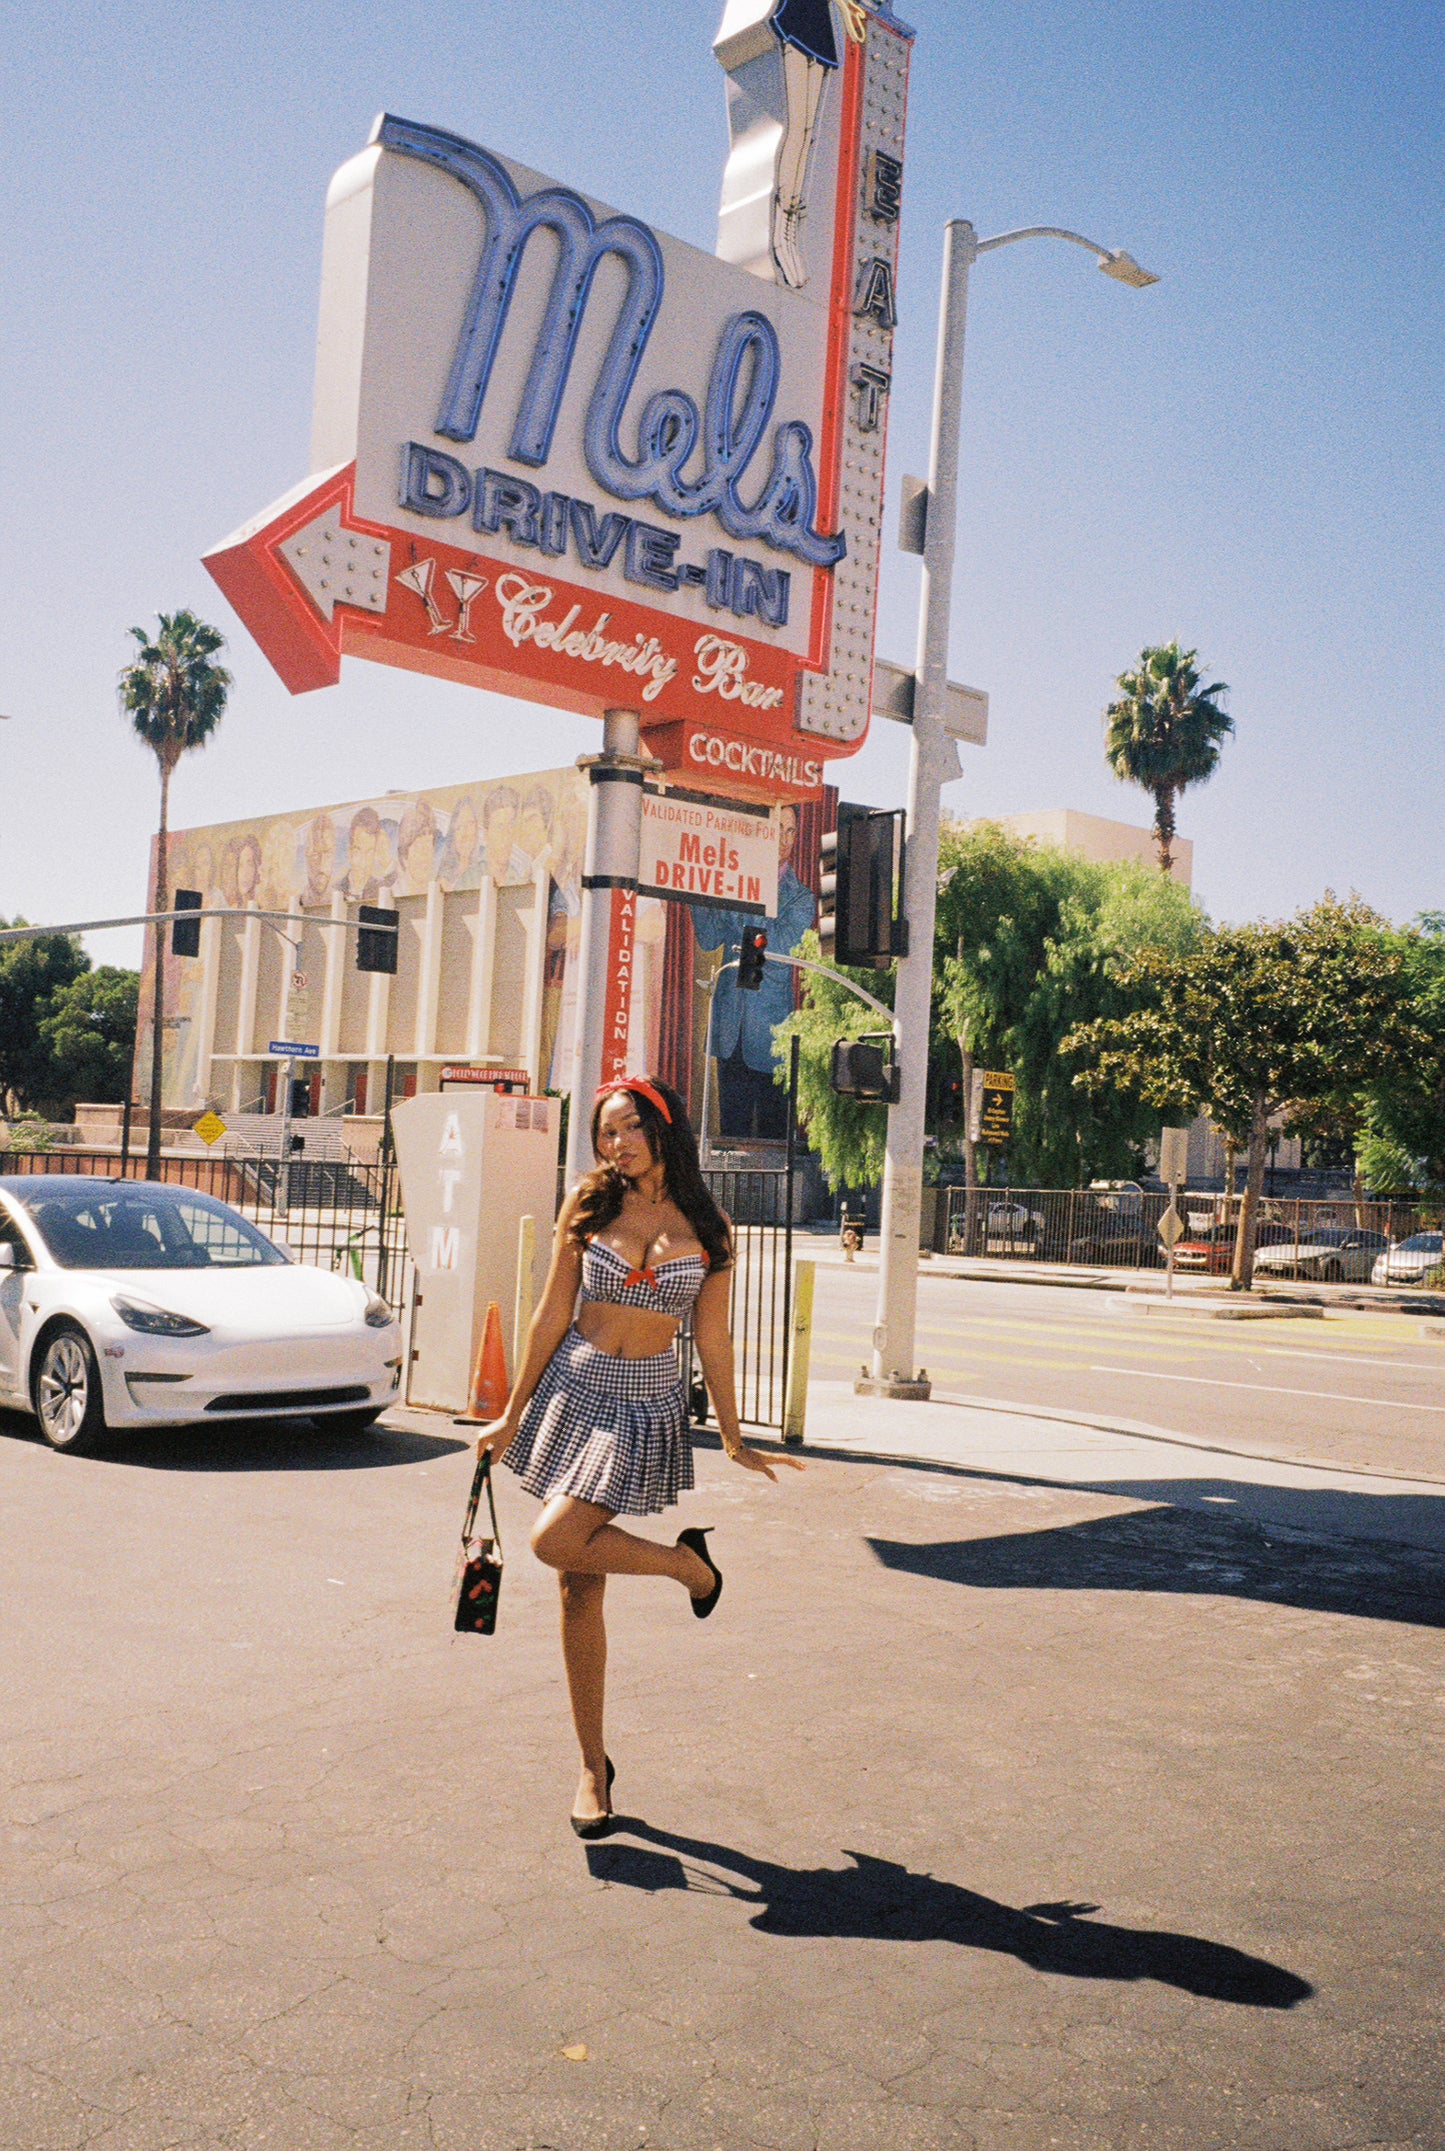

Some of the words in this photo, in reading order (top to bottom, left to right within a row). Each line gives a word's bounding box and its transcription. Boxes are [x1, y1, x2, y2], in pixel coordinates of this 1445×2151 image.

[382, 112, 847, 566] Mels
[853, 149, 904, 434] EAT
[398, 440, 791, 628] DRIVE-IN
[495, 571, 681, 701] Celebrity
[692, 634, 785, 710] Bar
[642, 799, 703, 827] VALIDATED
[706, 811, 753, 837] PARKING
[755, 821, 776, 841] FOR
[690, 732, 823, 788] COCKTAILS
[655, 860, 761, 901] DRIVE-IN
[679, 832, 740, 872] Mels
[613, 889, 634, 1040] VALIDATION
[431, 1114, 463, 1270] ATM
